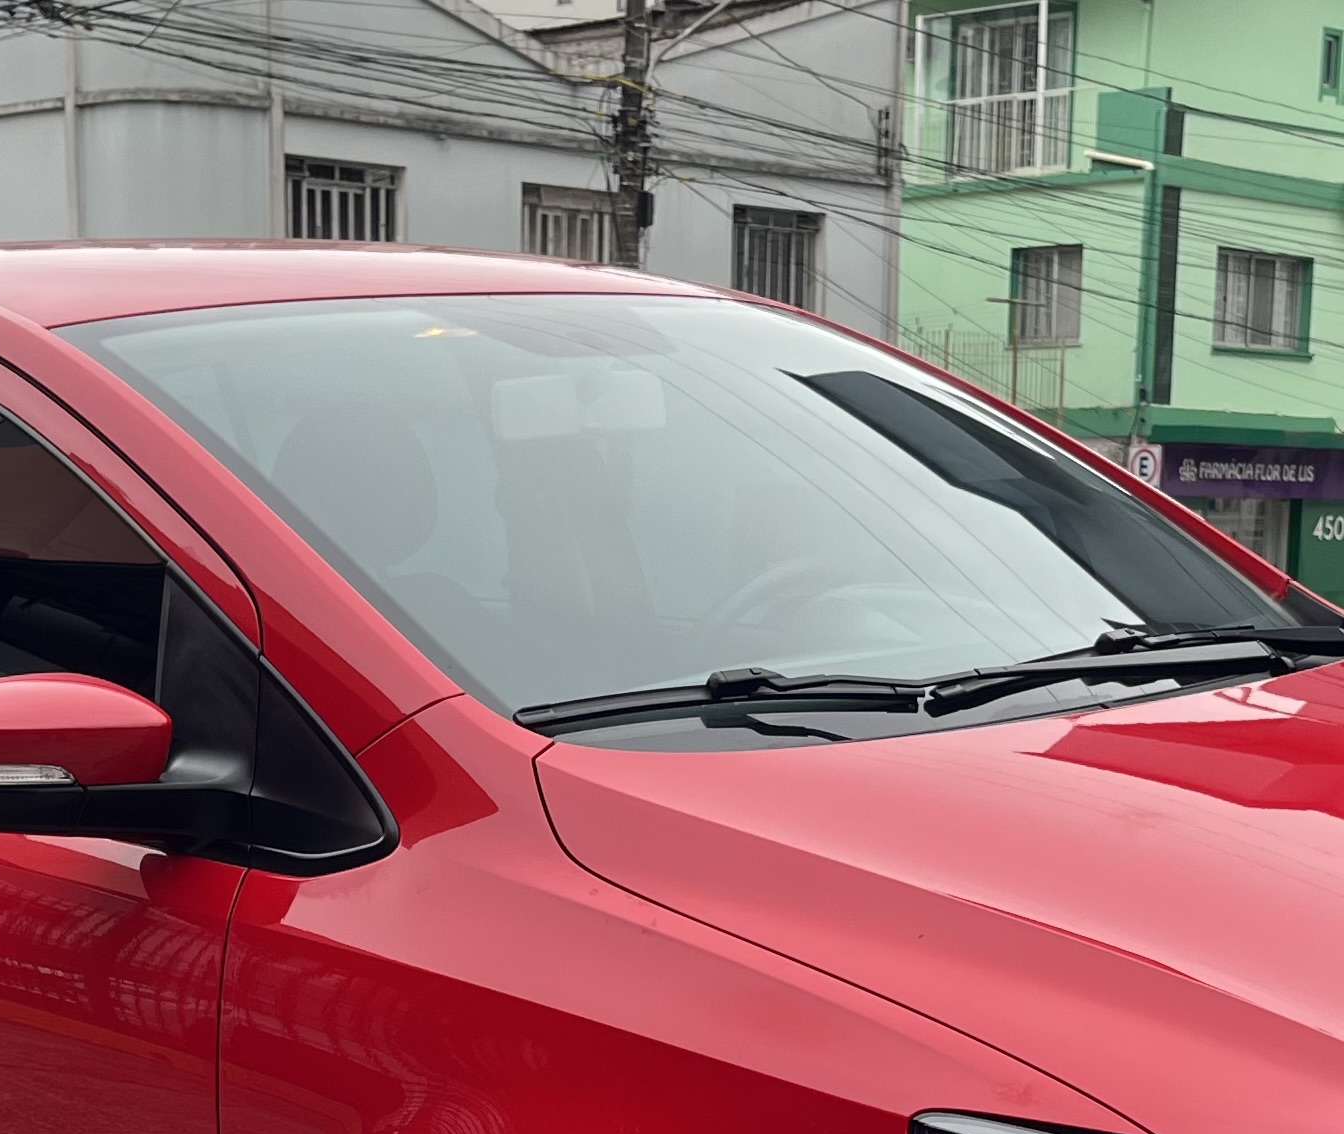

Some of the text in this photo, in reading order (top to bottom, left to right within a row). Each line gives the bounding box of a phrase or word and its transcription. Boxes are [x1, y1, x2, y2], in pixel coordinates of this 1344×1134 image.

[1139, 456, 1149, 477] E
[1199, 459, 1315, 483] FARMÁCIA FLOR DE LIS
